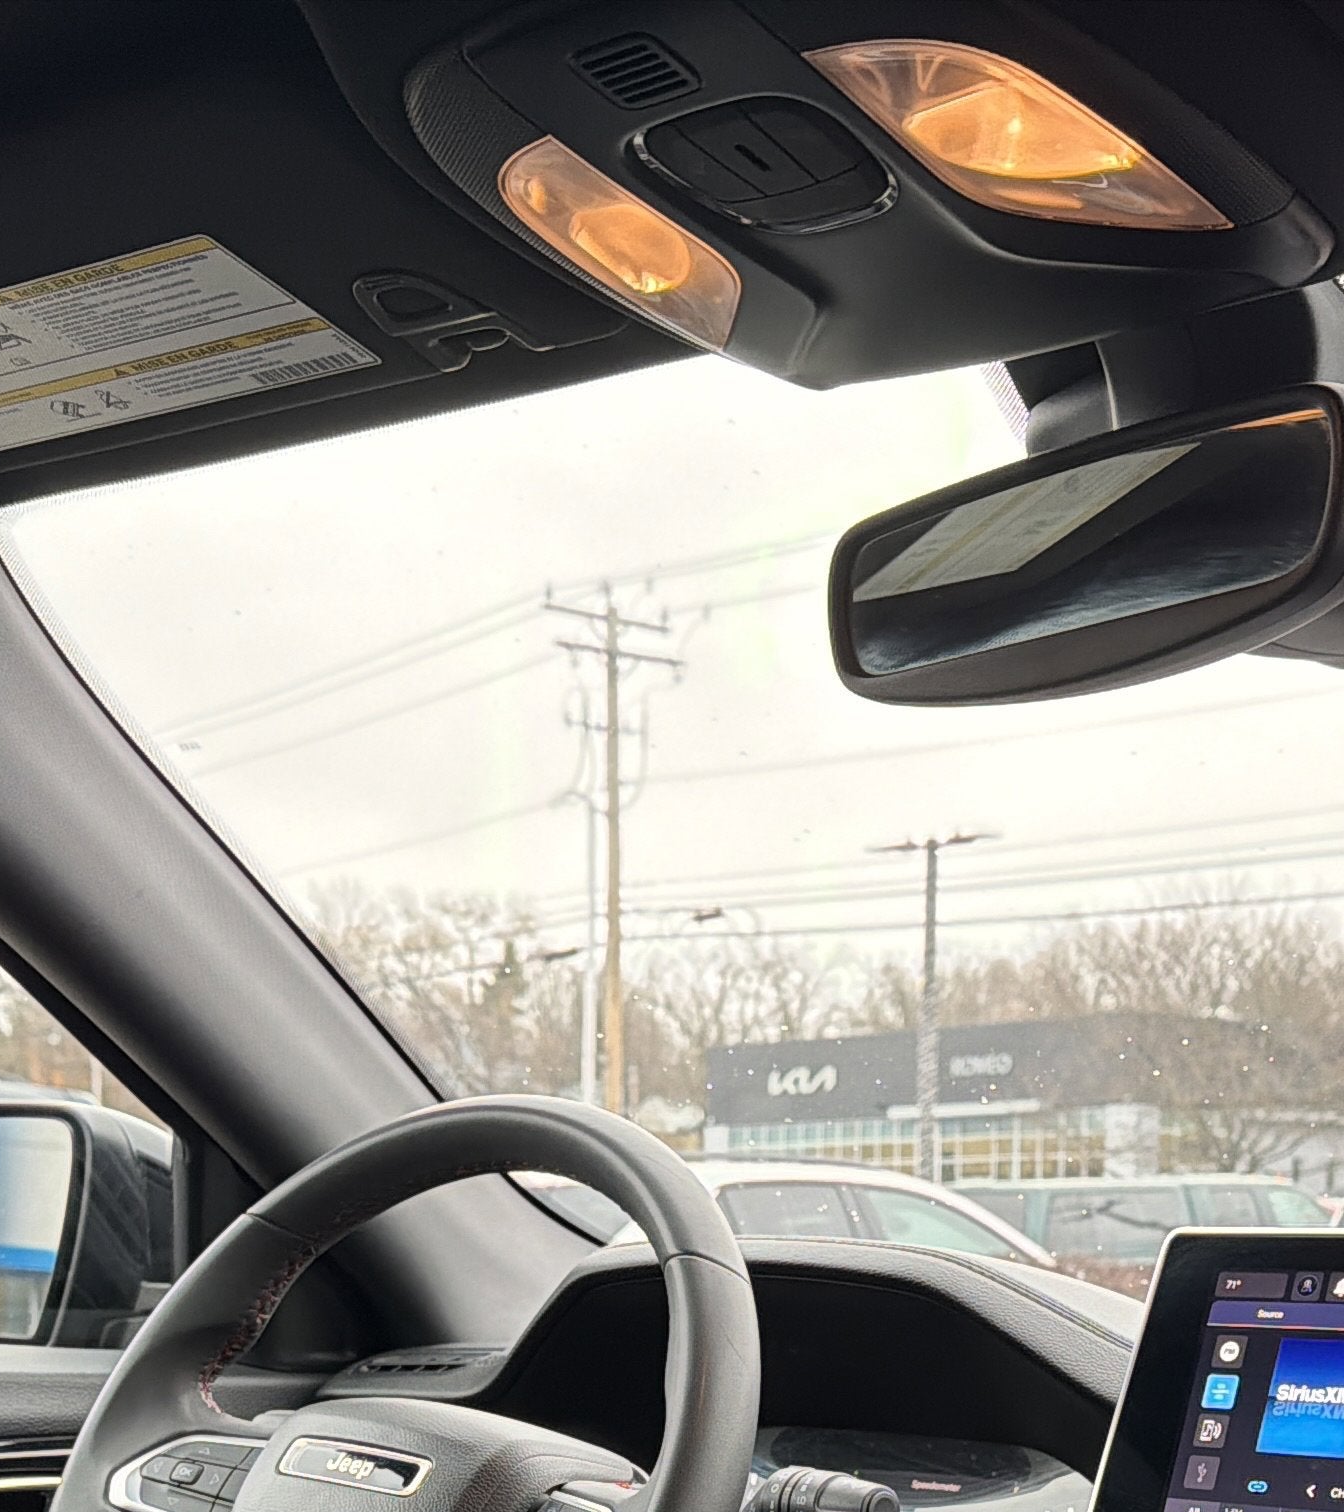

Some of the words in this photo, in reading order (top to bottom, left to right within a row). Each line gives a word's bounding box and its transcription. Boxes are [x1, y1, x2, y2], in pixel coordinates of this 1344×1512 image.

[768, 1064, 838, 1096] KIA
[1257, 1308, 1285, 1320] Source
[326, 1451, 375, 1480] Jeep
